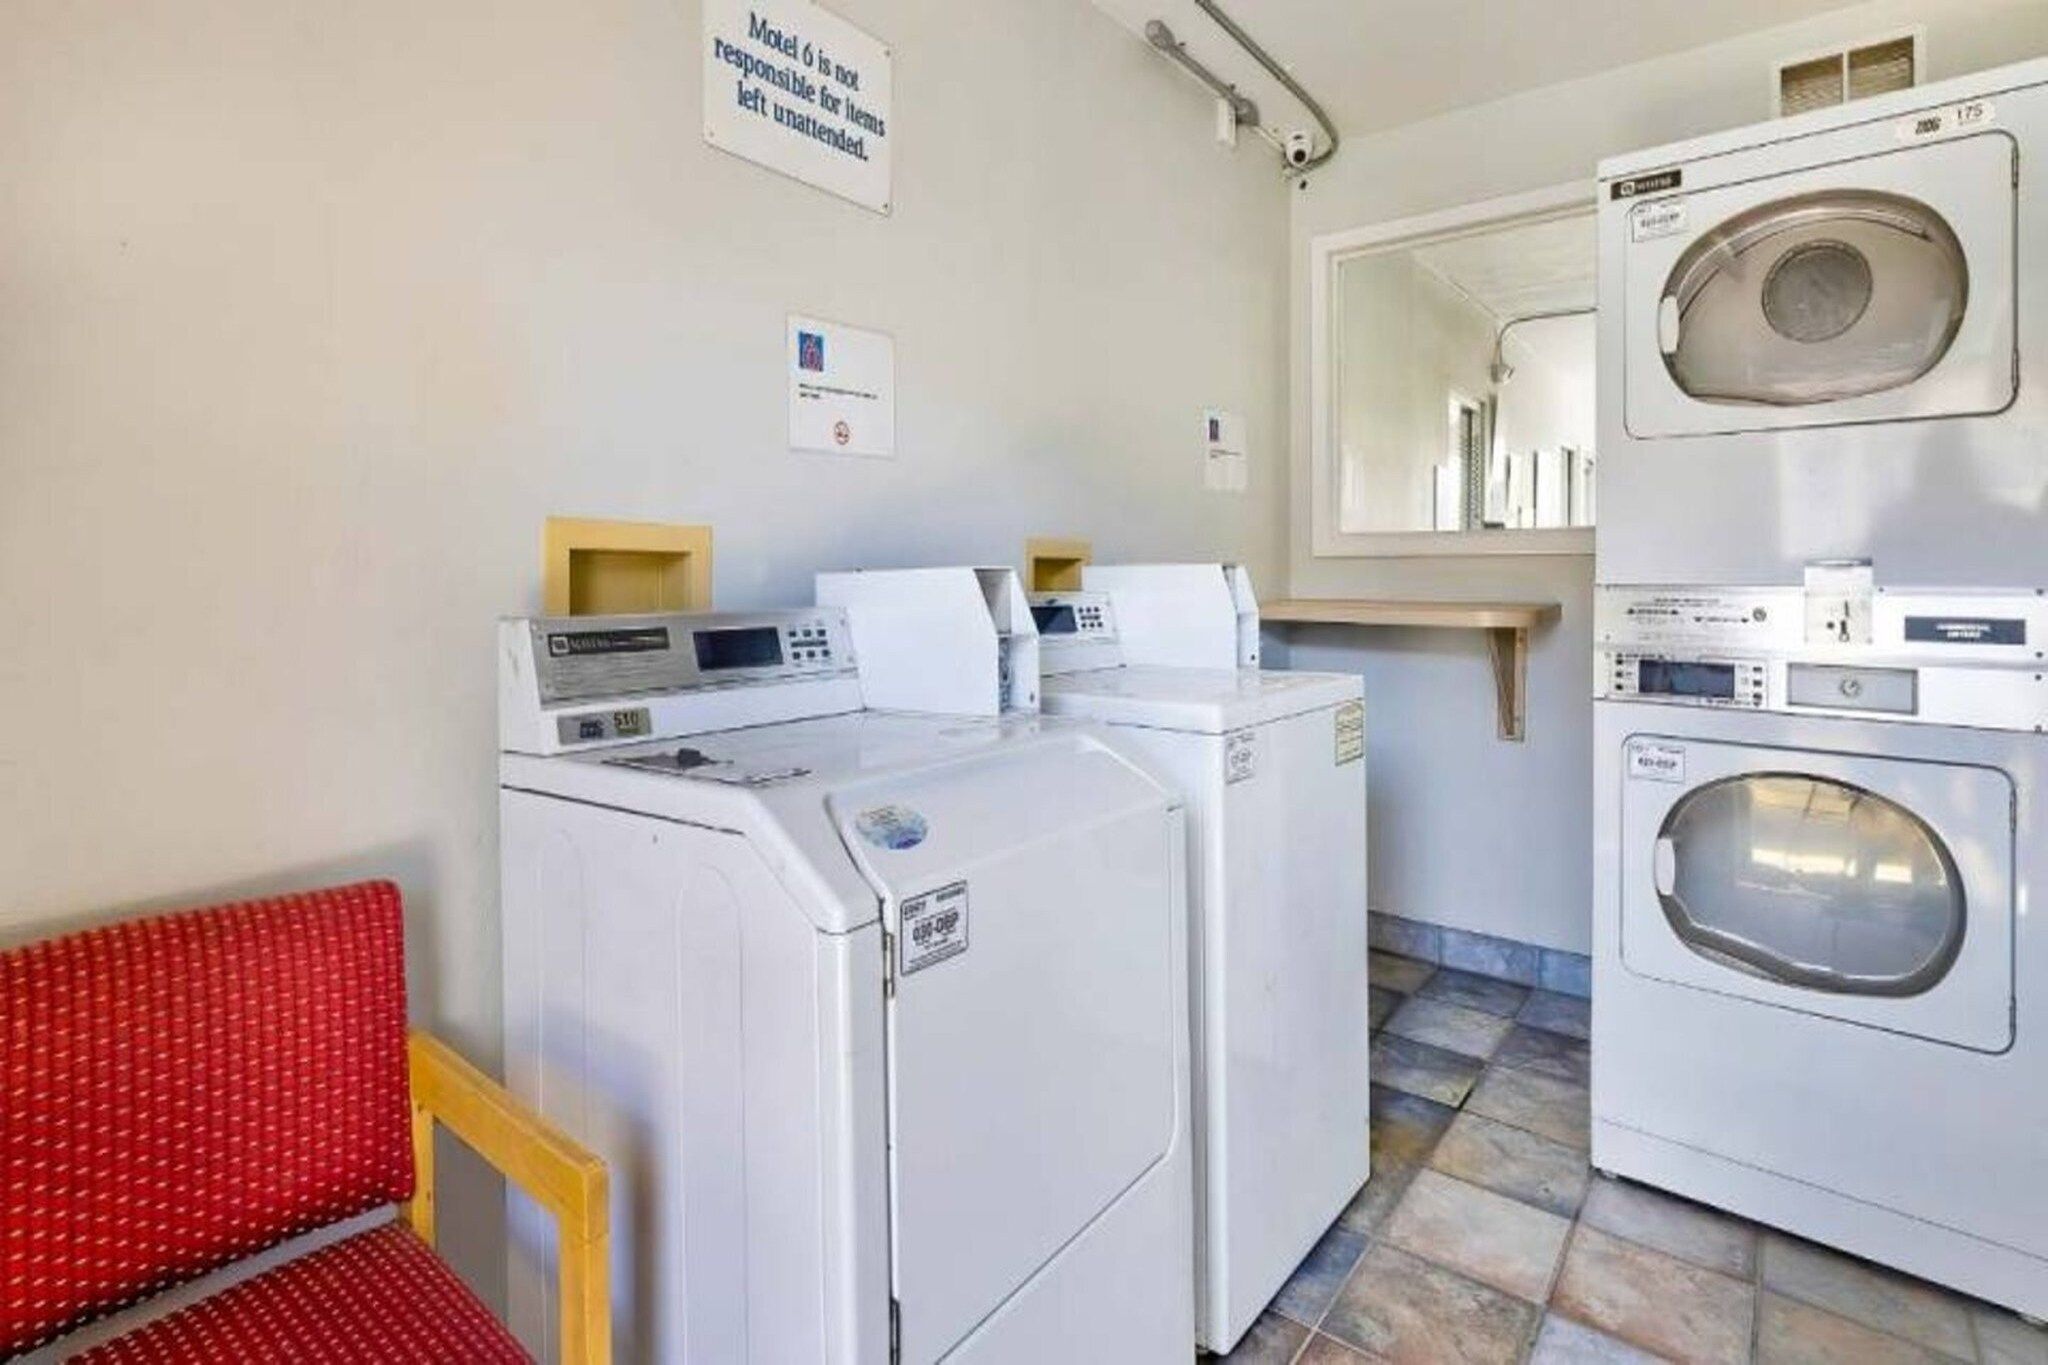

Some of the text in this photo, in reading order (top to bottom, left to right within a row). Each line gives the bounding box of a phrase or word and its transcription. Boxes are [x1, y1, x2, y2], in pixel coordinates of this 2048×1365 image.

[714, 36, 886, 137] responsible for items
[749, 11, 860, 92] Motel 6 is not
[737, 79, 869, 162] left unattended.
